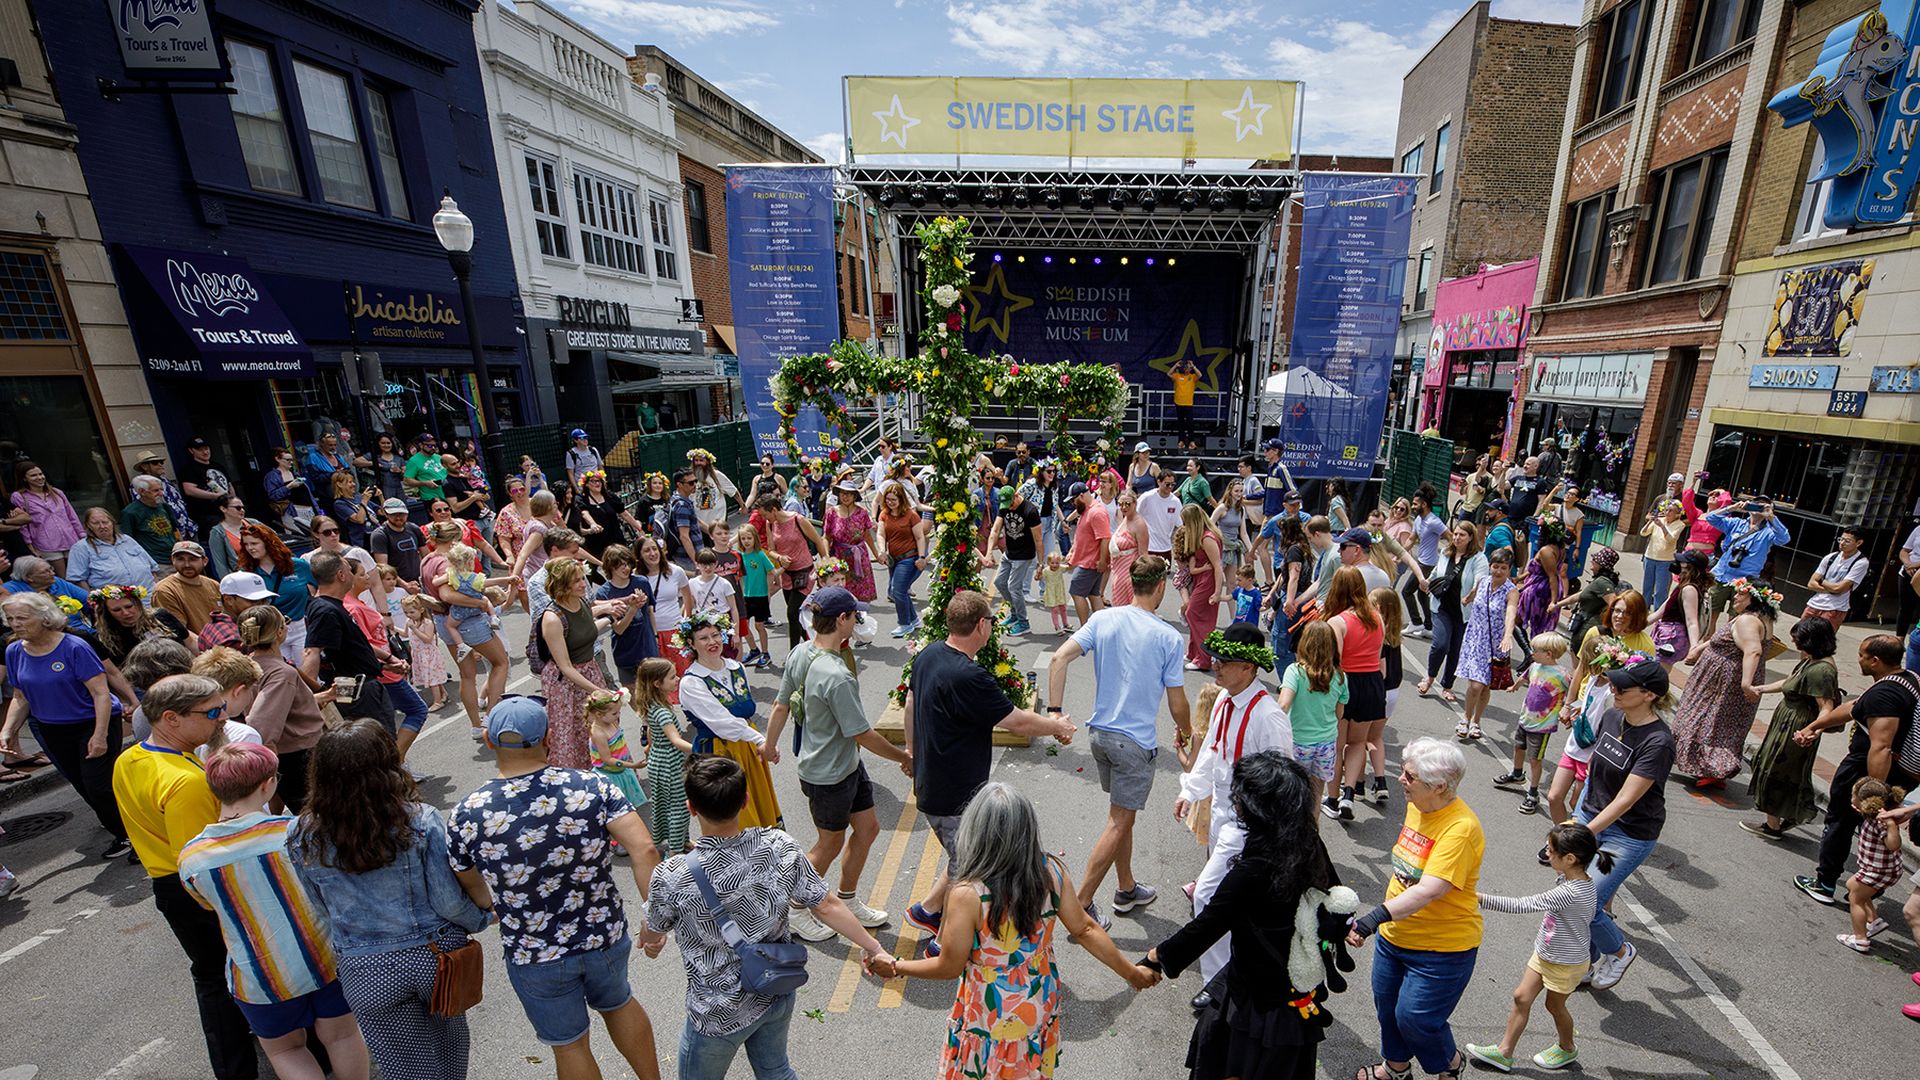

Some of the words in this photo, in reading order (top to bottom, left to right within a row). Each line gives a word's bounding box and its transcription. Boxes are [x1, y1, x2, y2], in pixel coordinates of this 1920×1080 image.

[125, 37, 159, 51] Tours
[161, 42, 168, 50] &
[169, 37, 208, 51] Travel
[947, 102, 1086, 132] SWEDISH
[1097, 104, 1194, 133] STAGE
[750, 264, 785, 272] SATURDAY
[167, 259, 259, 317] Mena
[558, 295, 631, 330] RAYGUN
[1795, 296, 1831, 336] 90
[192, 328, 240, 344] Tours
[241, 330, 255, 344] &
[250, 330, 298, 344] Travel
[372, 326, 404, 337] artisan
[405, 328, 445, 339] collective
[567, 330, 610, 348] GREATEST
[611, 334, 636, 348] STORE
[637, 336, 645, 348] IN
[645, 337, 660, 349] THE
[1793, 334, 1823, 345] BIRTHDAY
[148, 359, 190, 371] 5209-2nd
[222, 360, 301, 371] www.mena.travel
[1542, 371, 1574, 387] JAMESON
[1576, 371, 1599, 387] LOVES
[1600, 371, 1633, 387] DANGER
[1837, 392, 1857, 401] EST
[1832, 402, 1857, 413] 1934
[1327, 459, 1369, 468] FLOURISH
